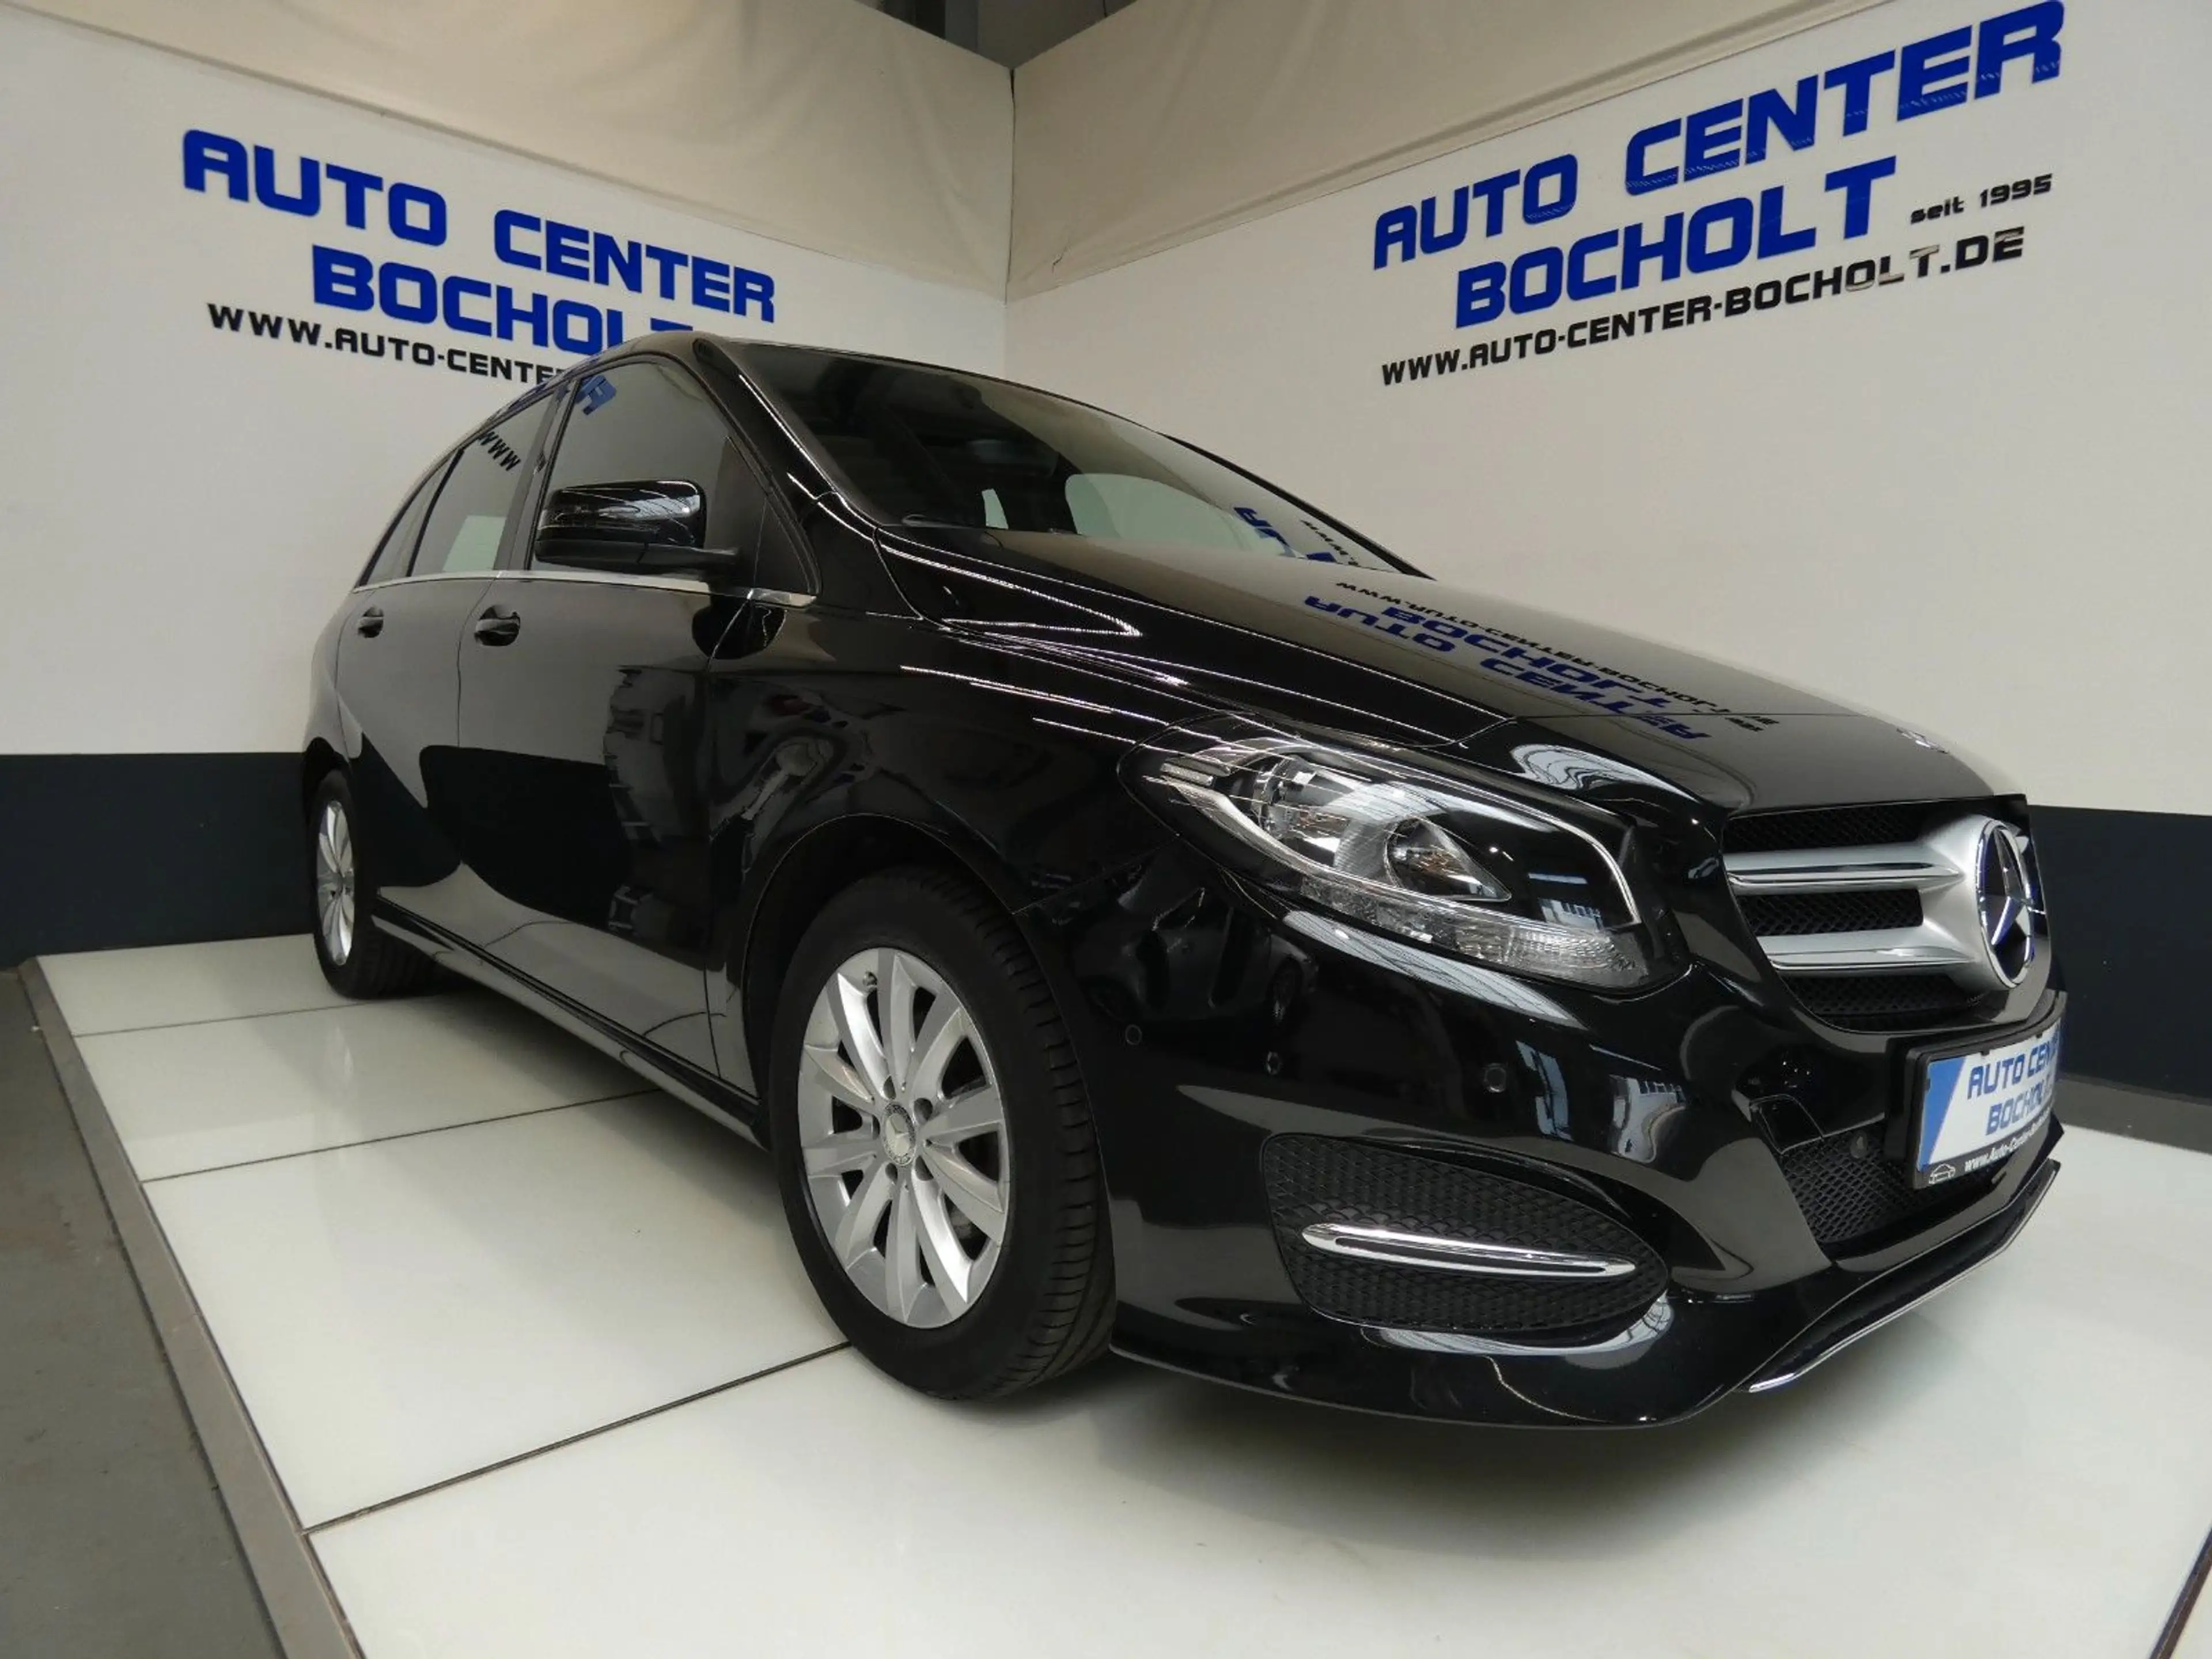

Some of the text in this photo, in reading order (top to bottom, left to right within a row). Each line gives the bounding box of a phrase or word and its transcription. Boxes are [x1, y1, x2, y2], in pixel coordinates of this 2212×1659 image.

[1374, 0, 2065, 270] AUTO CENTER
[1910, 173, 2053, 224] seit 1995
[183, 129, 775, 323] AUTO CENTER
[1382, 226, 2025, 385] WWW.AUTO-CENTER-BOCHOLT.DE
[1456, 156, 1896, 328] BOCHOLT
[207, 302, 569, 385] WWW.AUTO-CENTE
[1967, 1054, 2025, 1100] AUTO
